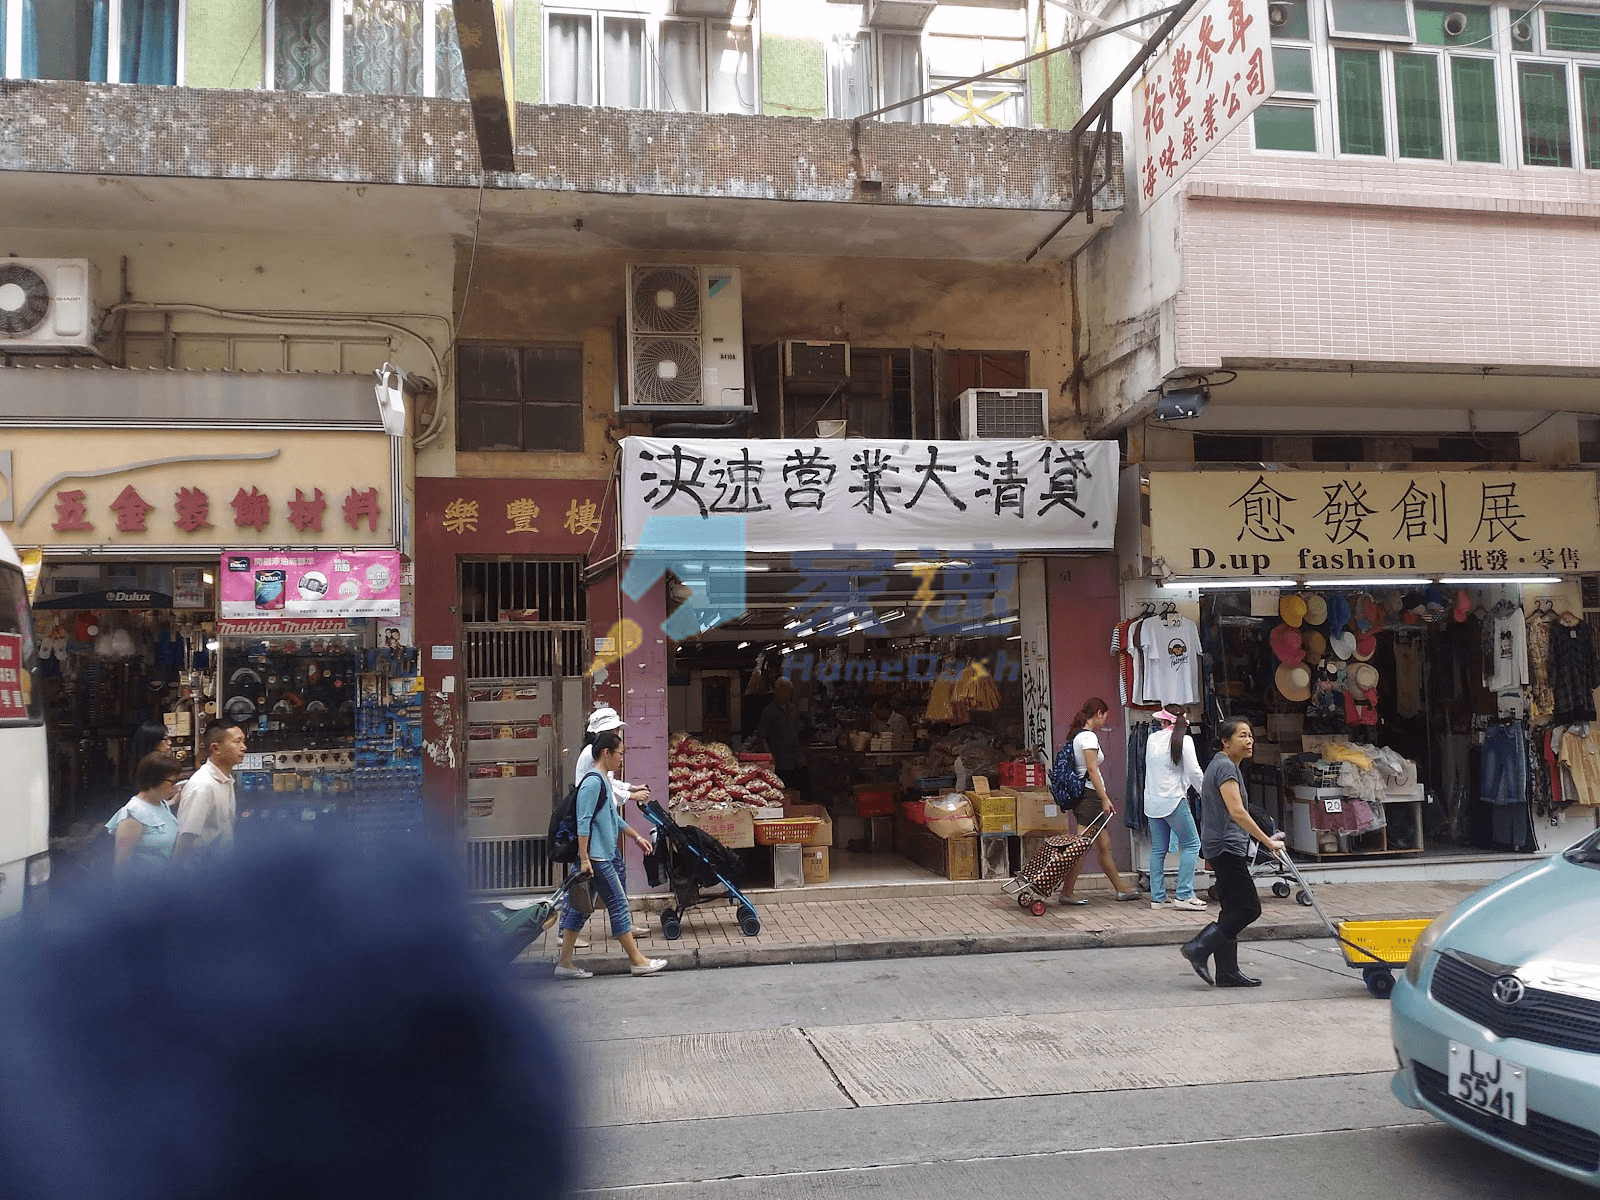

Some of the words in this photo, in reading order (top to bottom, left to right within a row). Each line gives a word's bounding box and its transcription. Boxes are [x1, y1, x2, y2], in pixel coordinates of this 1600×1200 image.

[51, 485, 381, 532] 五金裝飾材料
[443, 497, 602, 535] 樂豐樓
[1229, 475, 1531, 545] 愈發創展
[1190, 547, 1271, 575] D.up
[1297, 548, 1416, 570] fashion
[115, 592, 151, 601] Dulux
[1326, 801, 1341, 811] 20
[1470, 1049, 1501, 1084] LJ
[1459, 1072, 1514, 1120] 5541
